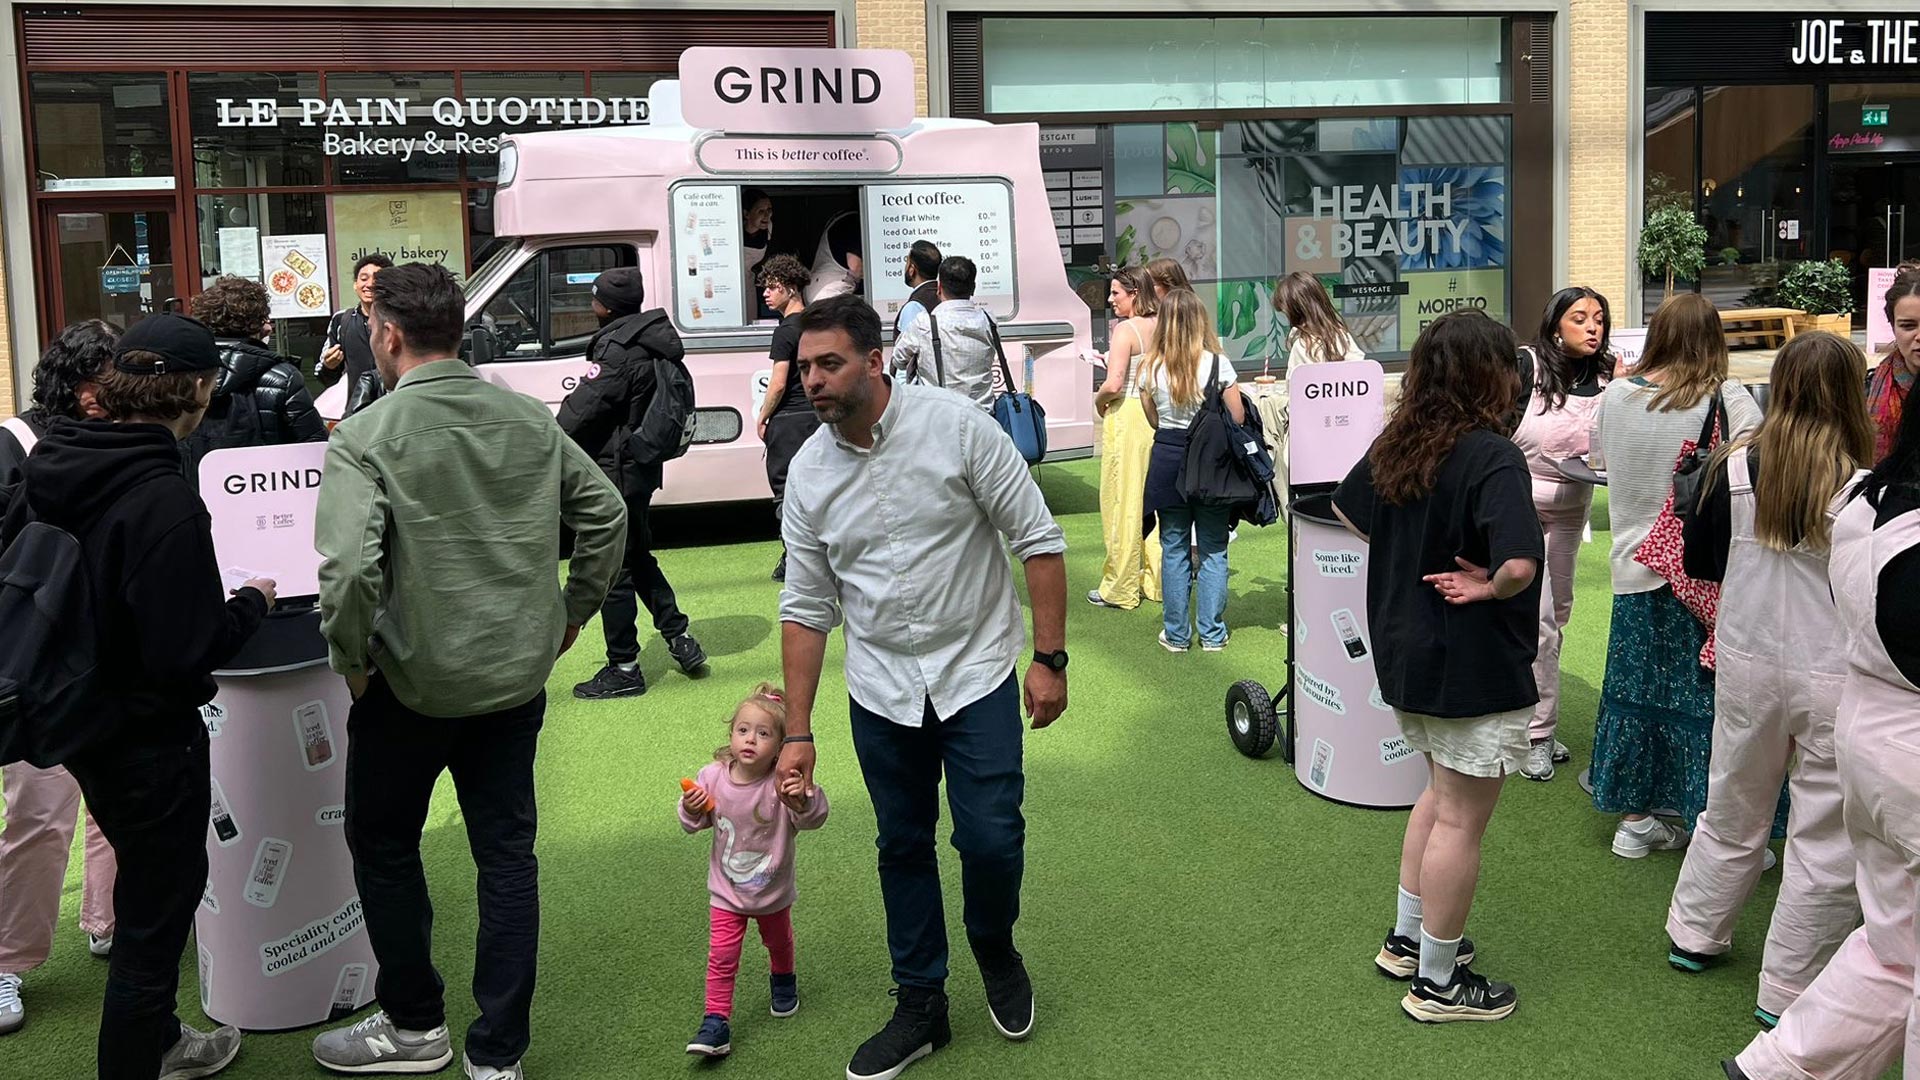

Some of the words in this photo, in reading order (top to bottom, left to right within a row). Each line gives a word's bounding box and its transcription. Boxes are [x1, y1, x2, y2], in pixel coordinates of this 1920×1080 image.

[1792, 19, 1844, 64] JOE
[1850, 49, 1866, 64] &
[1867, 19, 1919, 64] THE
[713, 65, 882, 104] GRIND
[216, 98, 278, 127] LE
[298, 97, 410, 127] PAIN
[432, 96, 651, 127] QUOTIDIE
[1041, 133, 1076, 141] ESTGATE
[324, 131, 416, 163] Bakery
[424, 130, 447, 154] &
[456, 132, 499, 154] Res
[735, 148, 765, 161] This
[767, 148, 779, 161] is
[781, 147, 820, 161] better
[882, 193, 913, 207] Iced
[917, 192, 965, 205] coffee.
[1313, 182, 1450, 221] HEALTH
[918, 214, 940, 222] White
[902, 228, 916, 236] Oat
[1296, 224, 1323, 261] &
[1331, 219, 1469, 258] BEAUTY
[884, 242, 901, 250] Iced
[903, 242, 914, 250] Bla
[934, 241, 952, 249] ffee
[351, 247, 367, 261] all
[401, 246, 449, 263] bakery
[885, 269, 902, 277] Iced
[1364, 270, 1376, 280] AT
[1351, 285, 1391, 294] WESTGATE
[1448, 277, 1457, 293] #
[1418, 298, 1463, 314] MORE
[1468, 297, 1487, 310] TO
[1305, 380, 1370, 399] GRIND
[223, 469, 321, 495] GRIND
[1315, 553, 1339, 562] Some
[1341, 553, 1360, 563] like
[1322, 564, 1329, 573] it
[1330, 564, 1354, 574] iced.
[1325, 685, 1336, 698] by
[264, 920, 332, 958] Speciality
[332, 900, 362, 926] coffe
[266, 947, 308, 972] cooled
[311, 932, 336, 953] and
[338, 913, 365, 933] cann
